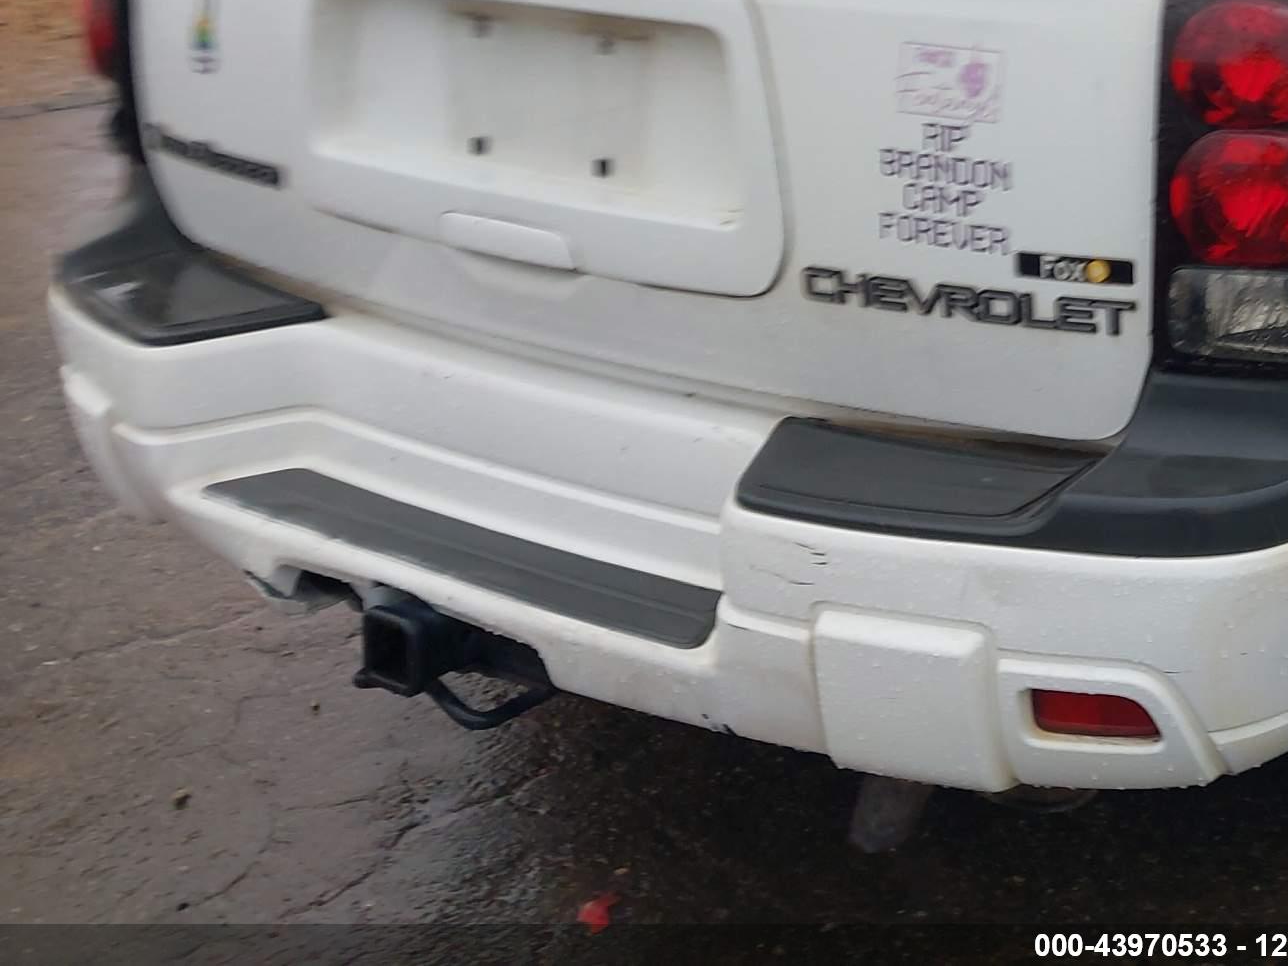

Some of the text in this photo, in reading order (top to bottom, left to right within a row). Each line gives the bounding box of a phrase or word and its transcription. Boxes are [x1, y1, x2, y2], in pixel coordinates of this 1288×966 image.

[921, 123, 970, 152] RIP
[879, 148, 1013, 192] BRANDON
[902, 183, 985, 218] CAMP
[878, 212, 1010, 256] FOREVER
[803, 265, 1137, 337] CHEVROLET
